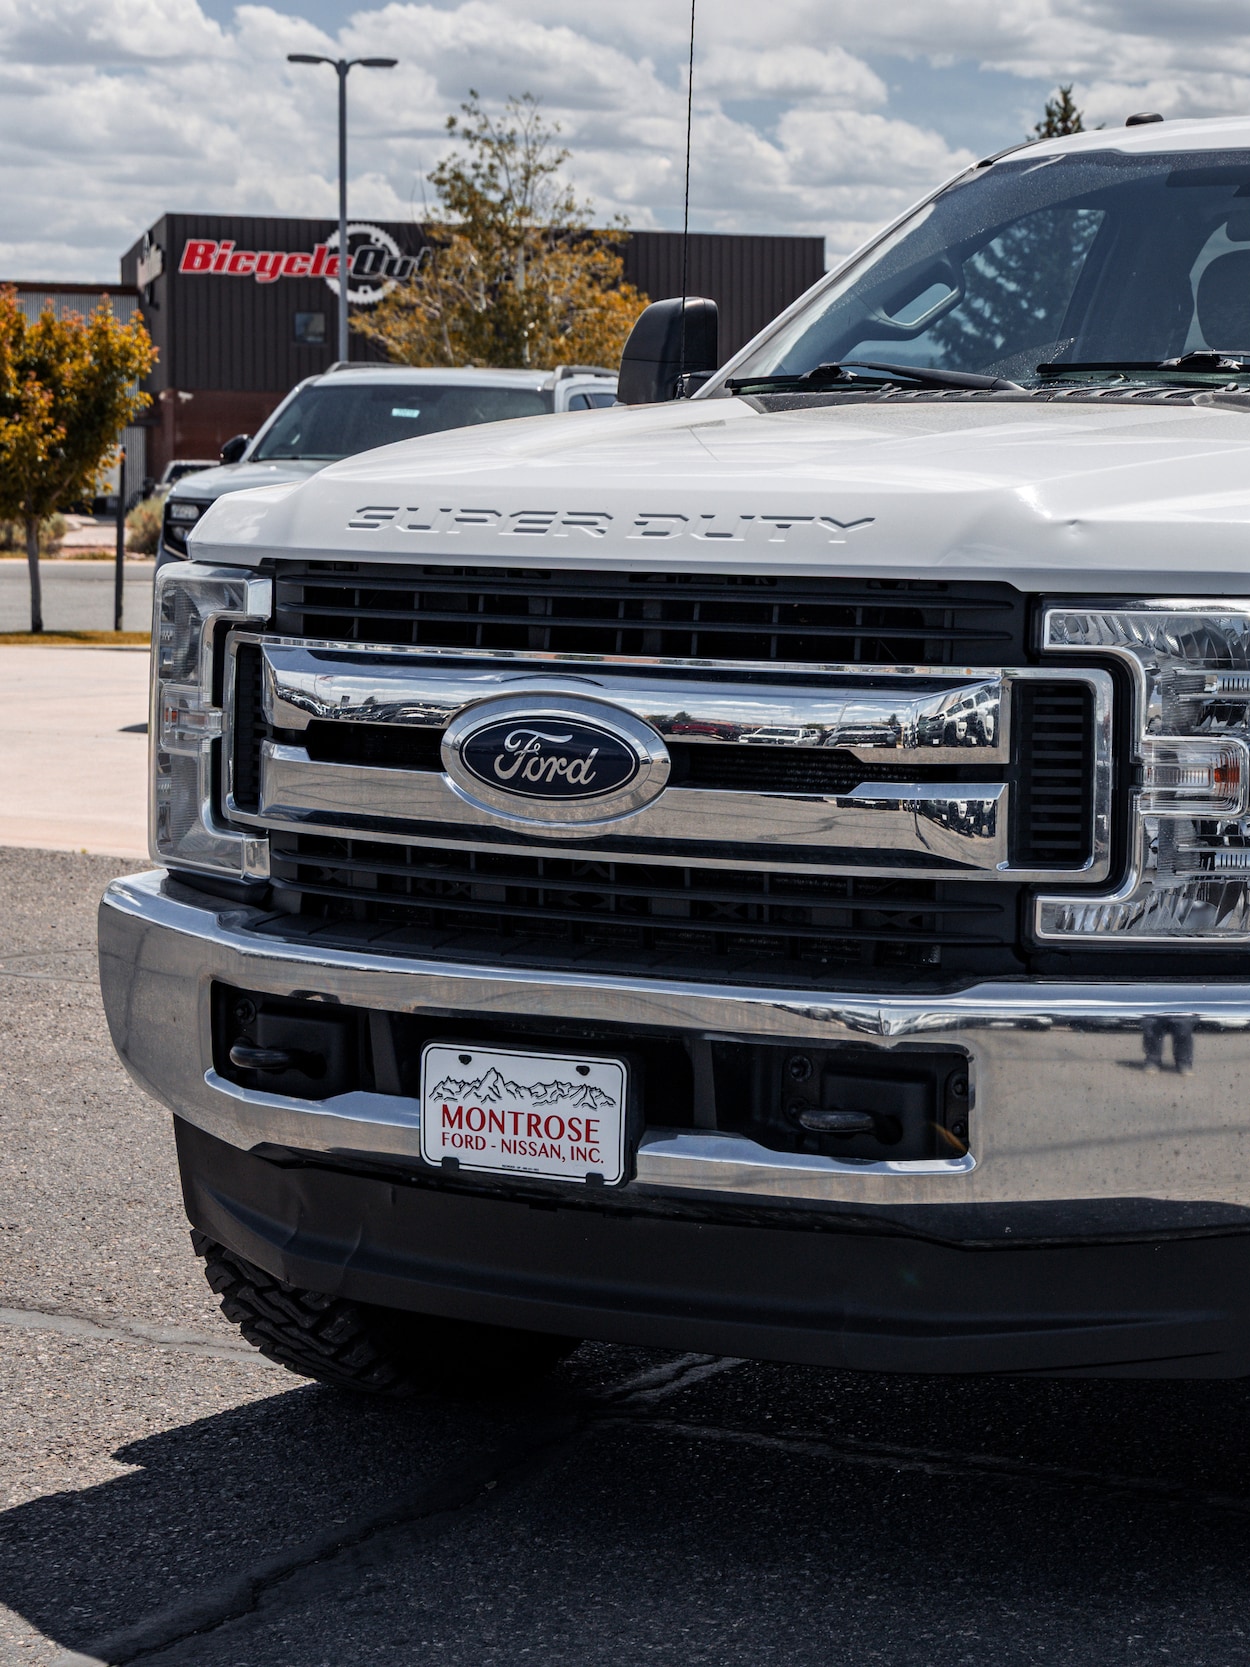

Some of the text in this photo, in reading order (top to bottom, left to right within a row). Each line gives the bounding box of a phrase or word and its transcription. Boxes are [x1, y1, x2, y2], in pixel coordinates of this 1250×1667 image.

[345, 505, 876, 544] SUPER DUTY
[493, 728, 600, 786] Ford
[442, 1104, 600, 1144] MONTROSE
[442, 1132, 486, 1151] FORD
[501, 1139, 566, 1162] NISSAN,
[571, 1146, 604, 1164] INC.
